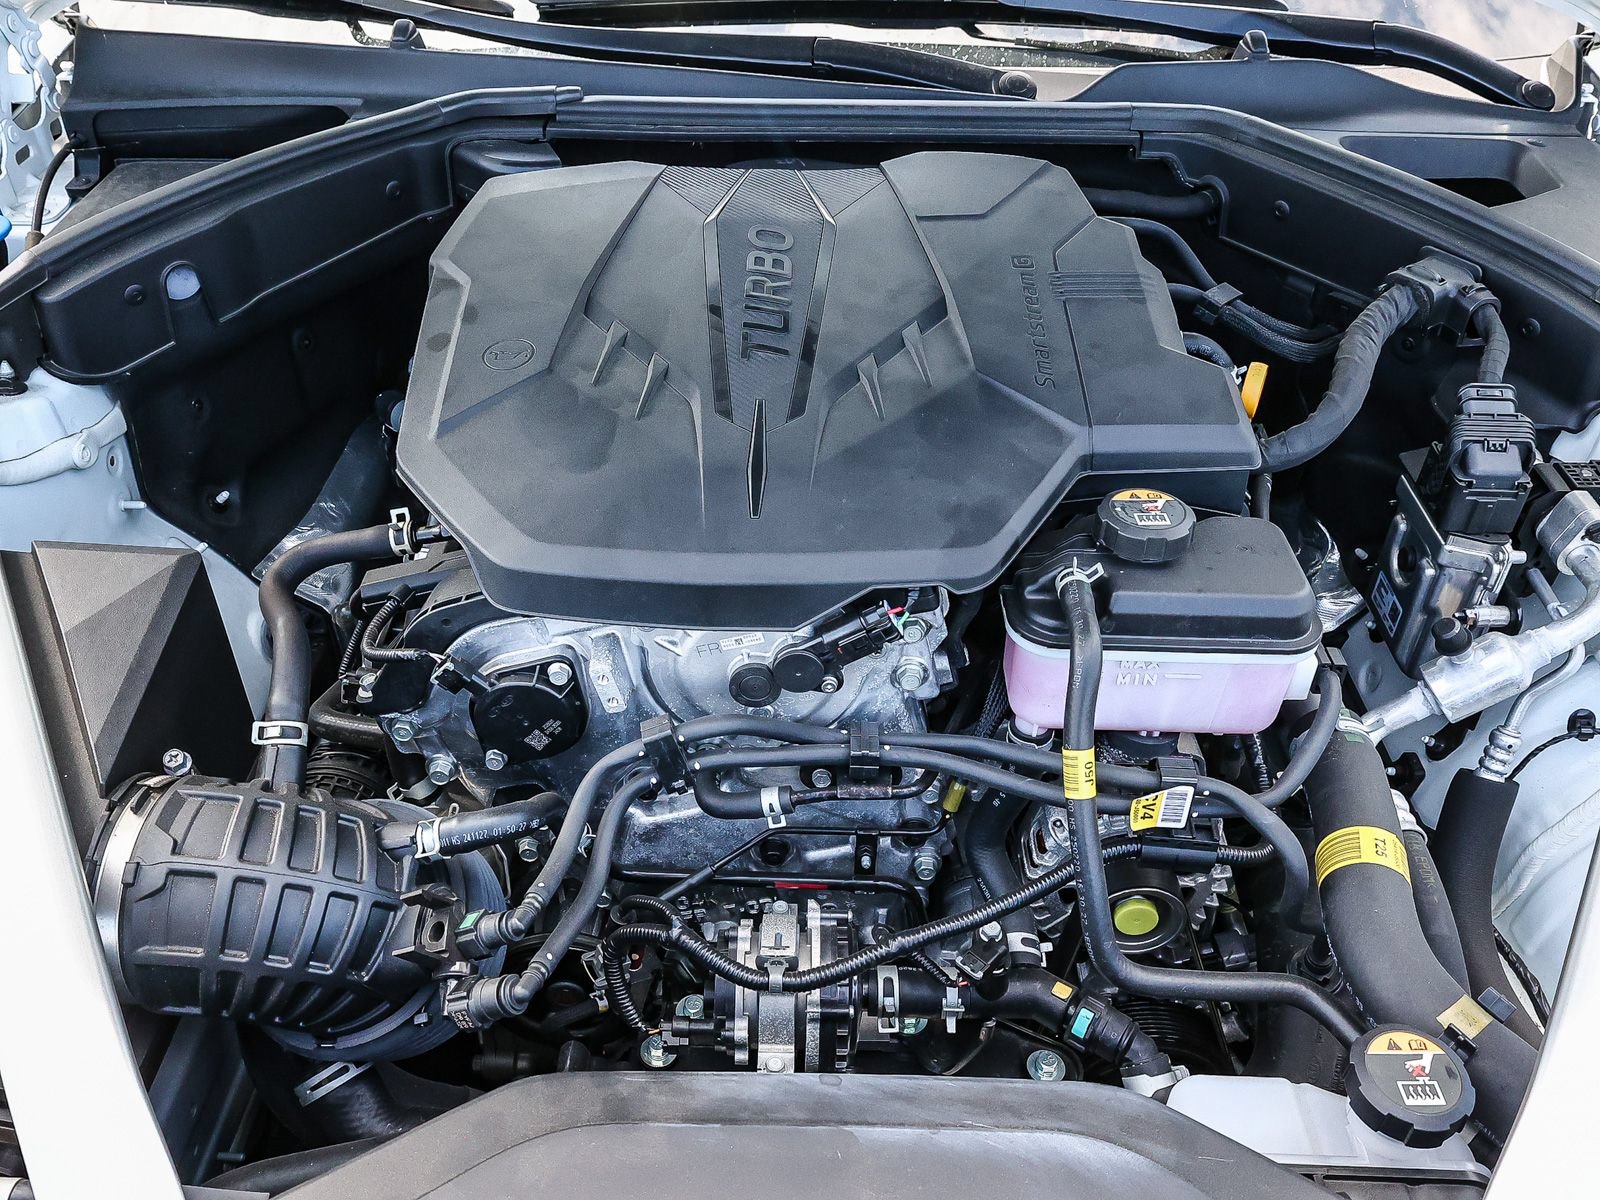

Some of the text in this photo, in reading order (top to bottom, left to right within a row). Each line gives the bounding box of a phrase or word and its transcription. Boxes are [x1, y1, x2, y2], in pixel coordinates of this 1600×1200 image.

[741, 223, 794, 361] TURBO
[1021, 272, 1056, 390] Smartstream
[1116, 672, 1158, 686] MIN
[1084, 760, 1094, 786] J50
[1374, 837, 1388, 858] T25
